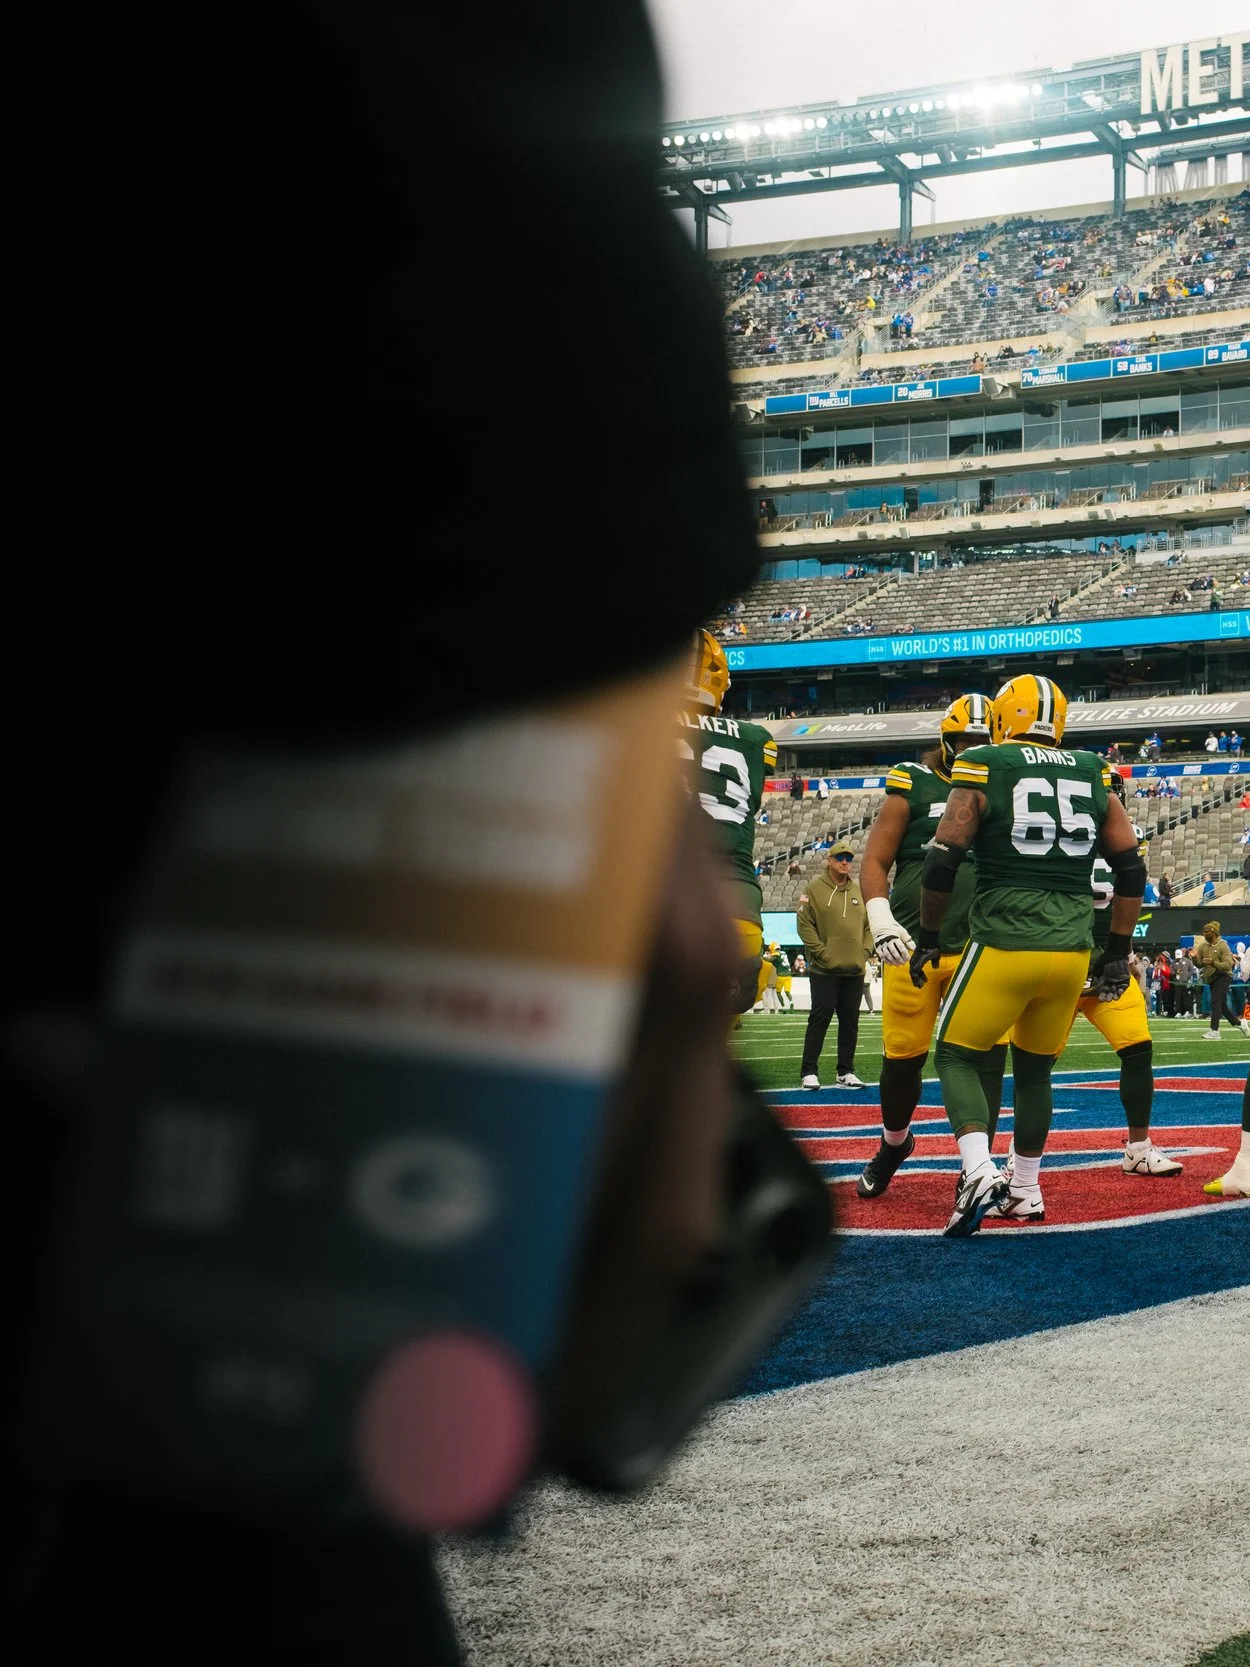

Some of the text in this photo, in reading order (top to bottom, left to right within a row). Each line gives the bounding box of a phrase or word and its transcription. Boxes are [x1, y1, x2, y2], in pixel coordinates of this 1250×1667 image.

[1117, 361, 1152, 373] 58 BANKS
[1022, 372, 1065, 385] 70 MARSHALL
[898, 387, 933, 399] 20 MORRIS
[819, 396, 849, 408] PARCELLS
[891, 627, 1082, 656] WORLD'S #1 IN ORTHOPEDICS
[1066, 701, 1240, 723] ETLIFE STADIUM
[674, 709, 740, 739] ALKER
[820, 721, 888, 734] MetLife
[1020, 747, 1077, 767] BANKS
[1011, 777, 1097, 857] 65
[1132, 924, 1149, 937] EY
